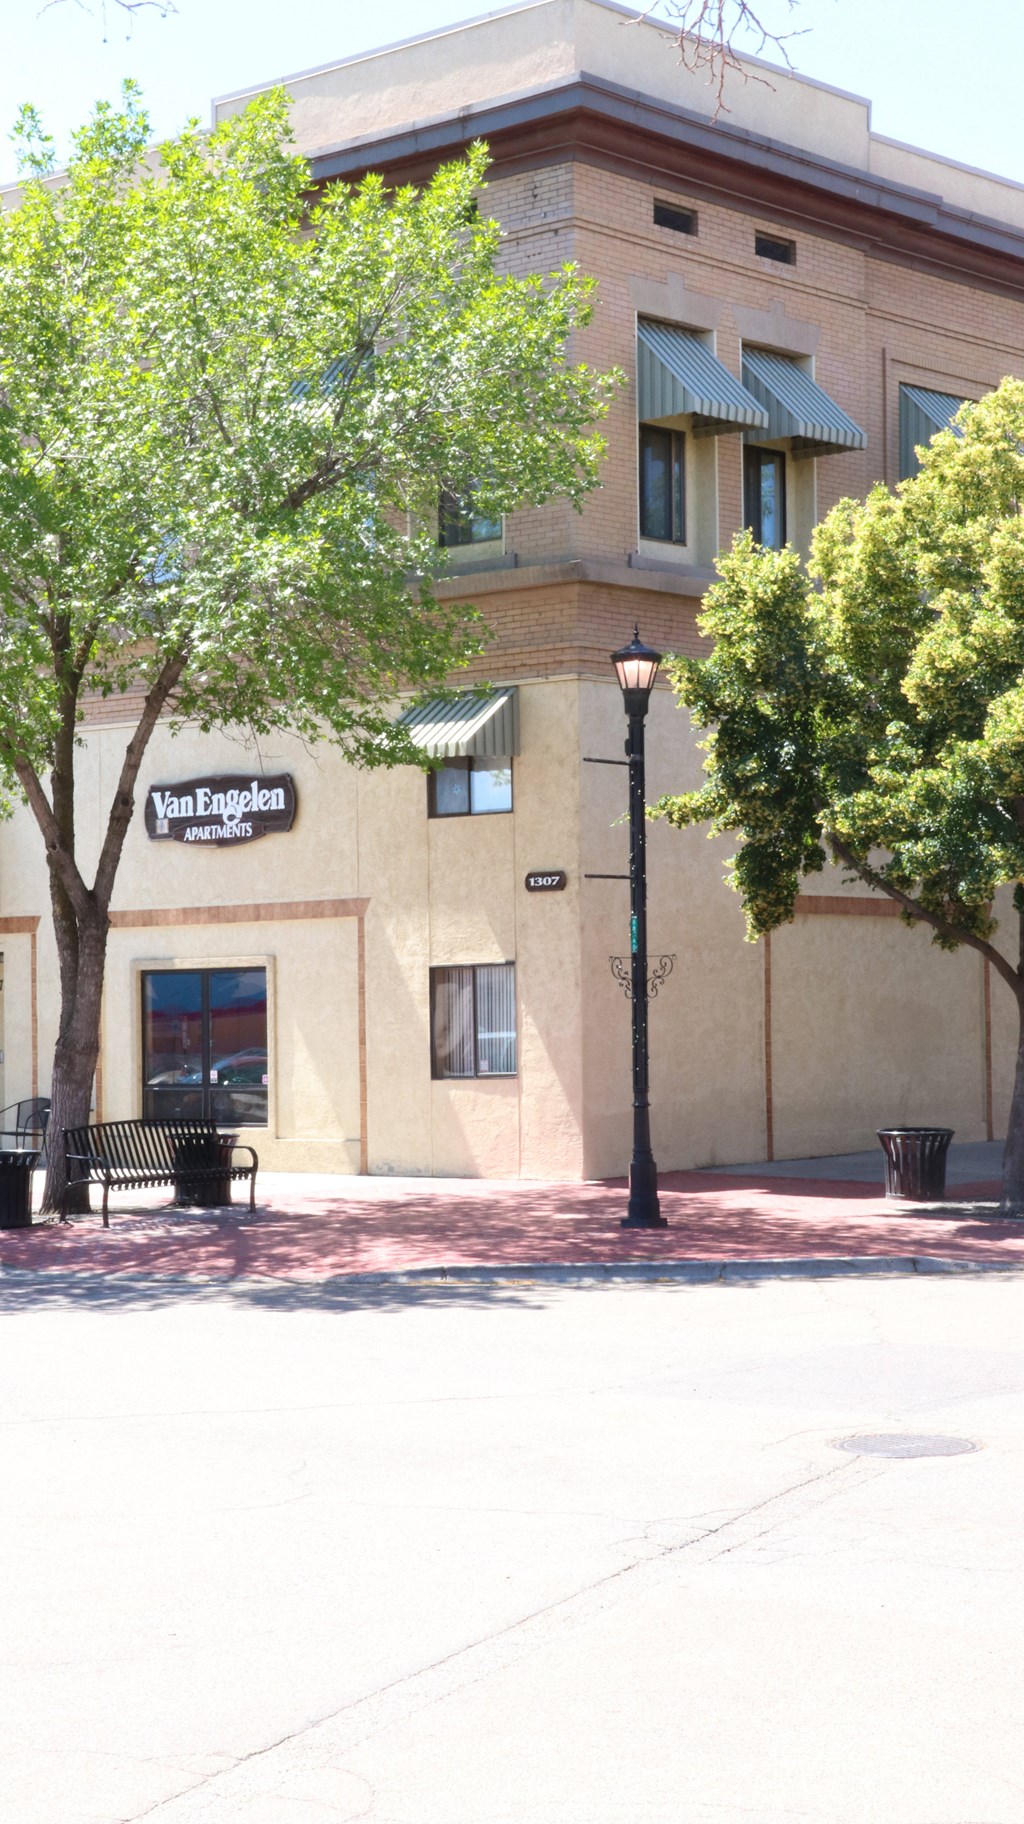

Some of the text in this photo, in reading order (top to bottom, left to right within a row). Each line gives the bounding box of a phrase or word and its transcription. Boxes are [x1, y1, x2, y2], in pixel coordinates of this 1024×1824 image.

[151, 780, 285, 825] Van Engelen
[183, 822, 252, 842] APARTMENTS
[529, 876, 560, 887] 1307
